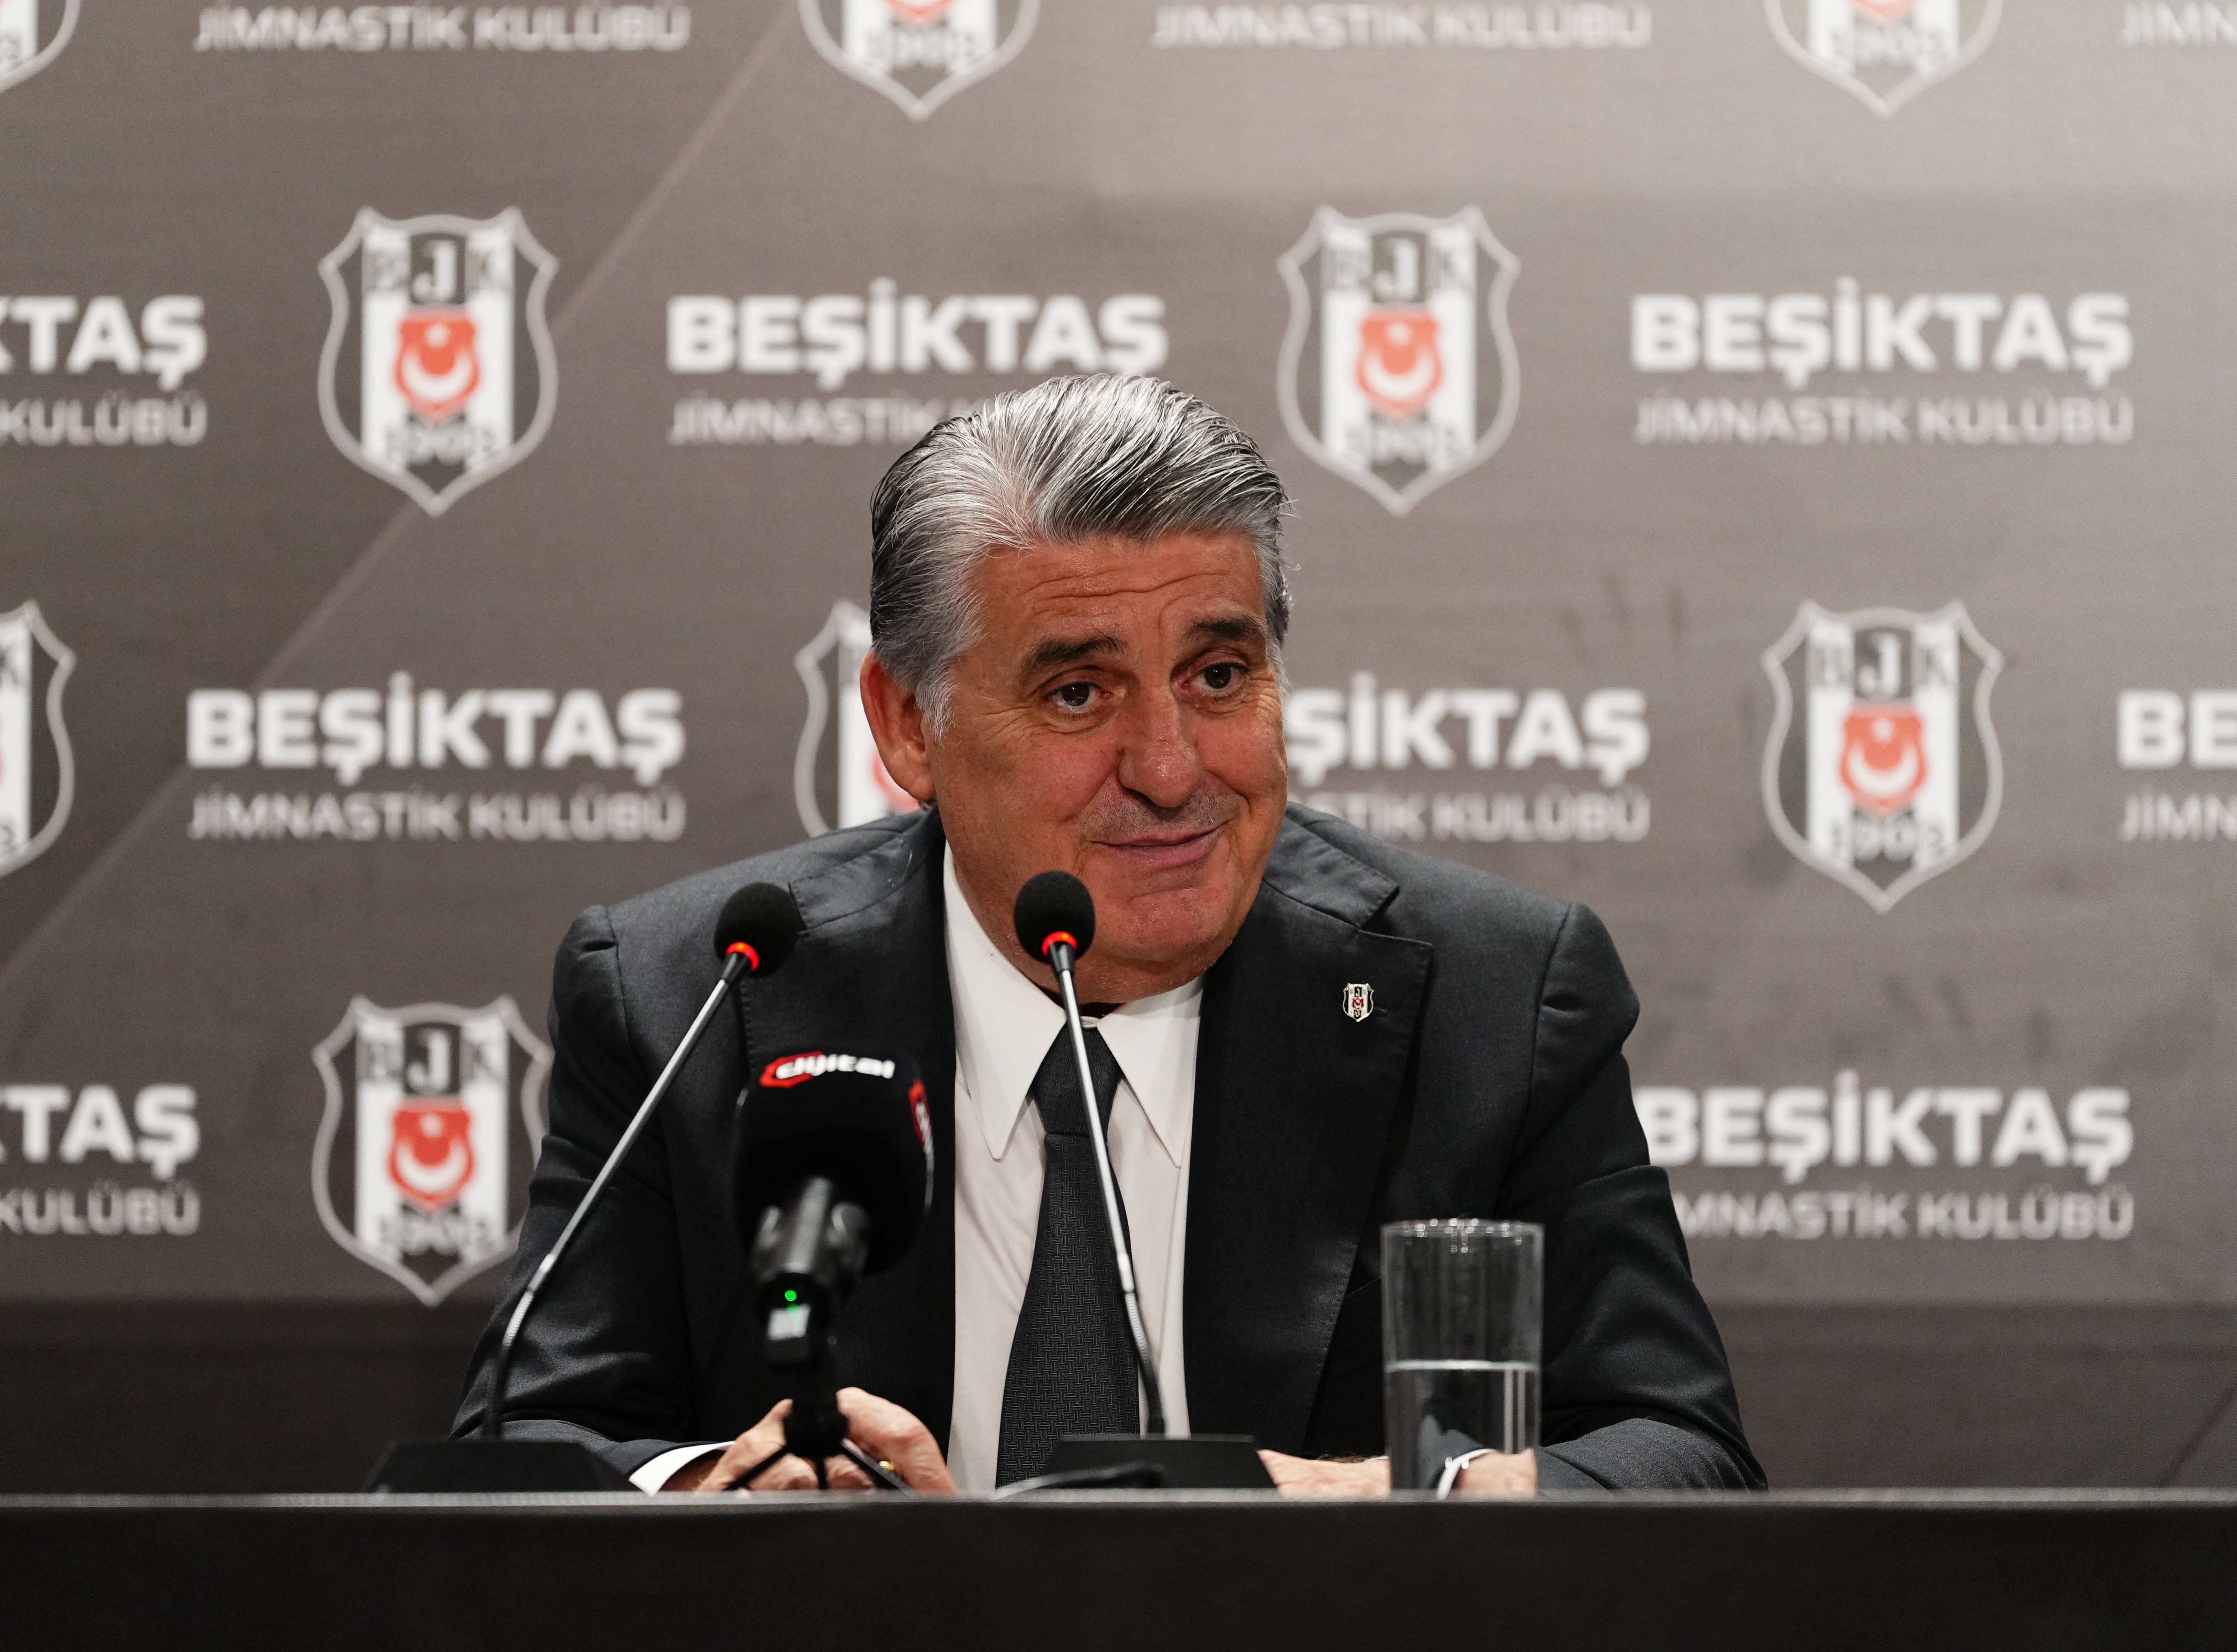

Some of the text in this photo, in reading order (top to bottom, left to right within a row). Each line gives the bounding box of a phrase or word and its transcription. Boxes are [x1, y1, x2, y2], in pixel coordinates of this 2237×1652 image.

[0, 296, 206, 391] TAŞ
[667, 278, 1168, 388] BEŞİKTAŞ
[1631, 277, 2134, 388] BEŞİKTAŞ
[1636, 389, 2134, 444] JİMNASTİK KULÜBÜ
[187, 671, 686, 785] BEŞİKTAŞ
[1284, 671, 1650, 786] ŞİKTAŞ
[188, 783, 686, 840] JİMNASTİK KULÜBÜ
[1432, 784, 1651, 842] KULÜBÜ
[0, 1084, 200, 1181] TAŞ
[1634, 1069, 2134, 1183] BEŞİKTAŞ
[1672, 1183, 2135, 1239] MNASTİK KULÜBÜ
